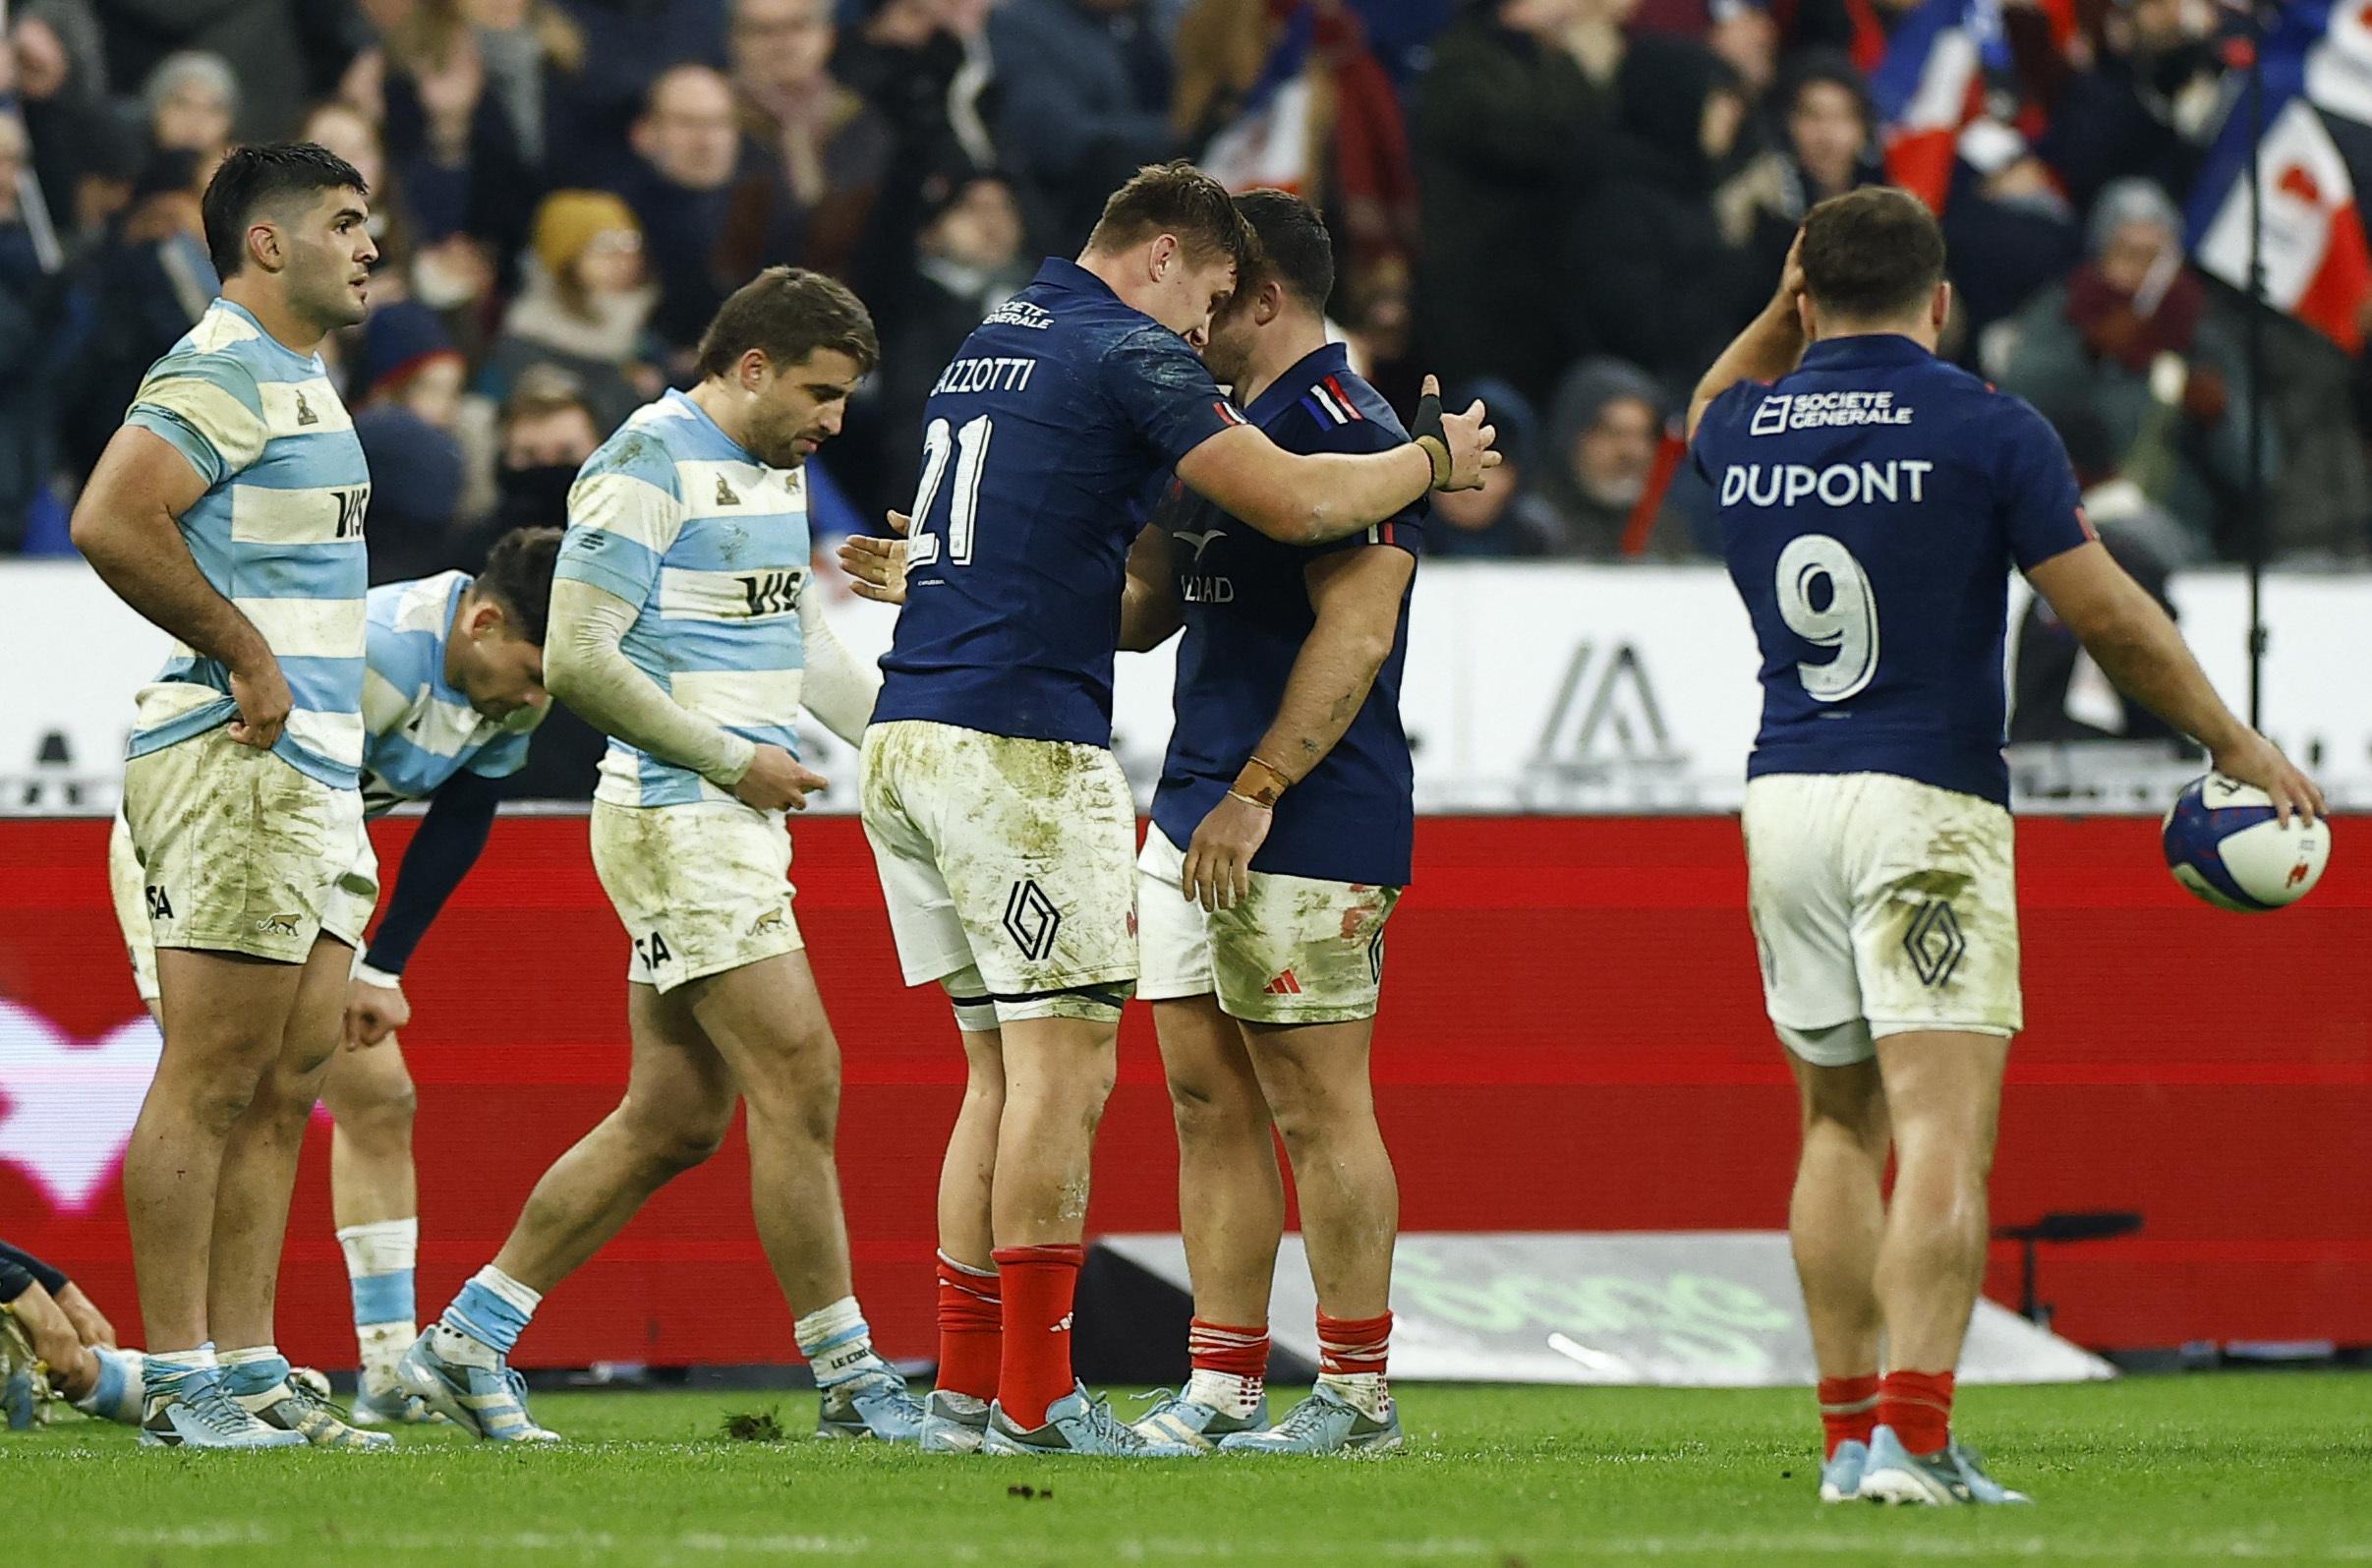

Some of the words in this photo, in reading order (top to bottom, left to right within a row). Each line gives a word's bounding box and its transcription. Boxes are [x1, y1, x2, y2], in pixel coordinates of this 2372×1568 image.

[930, 357, 1036, 397] AZZOTTI
[1789, 407, 1914, 430] GENERALE
[1793, 391, 1893, 413] SOCIETE
[906, 414, 993, 576] 21
[1721, 459, 1934, 506] DUPONT
[1775, 534, 1880, 702] 9
[831, 1357, 846, 1369] LE
